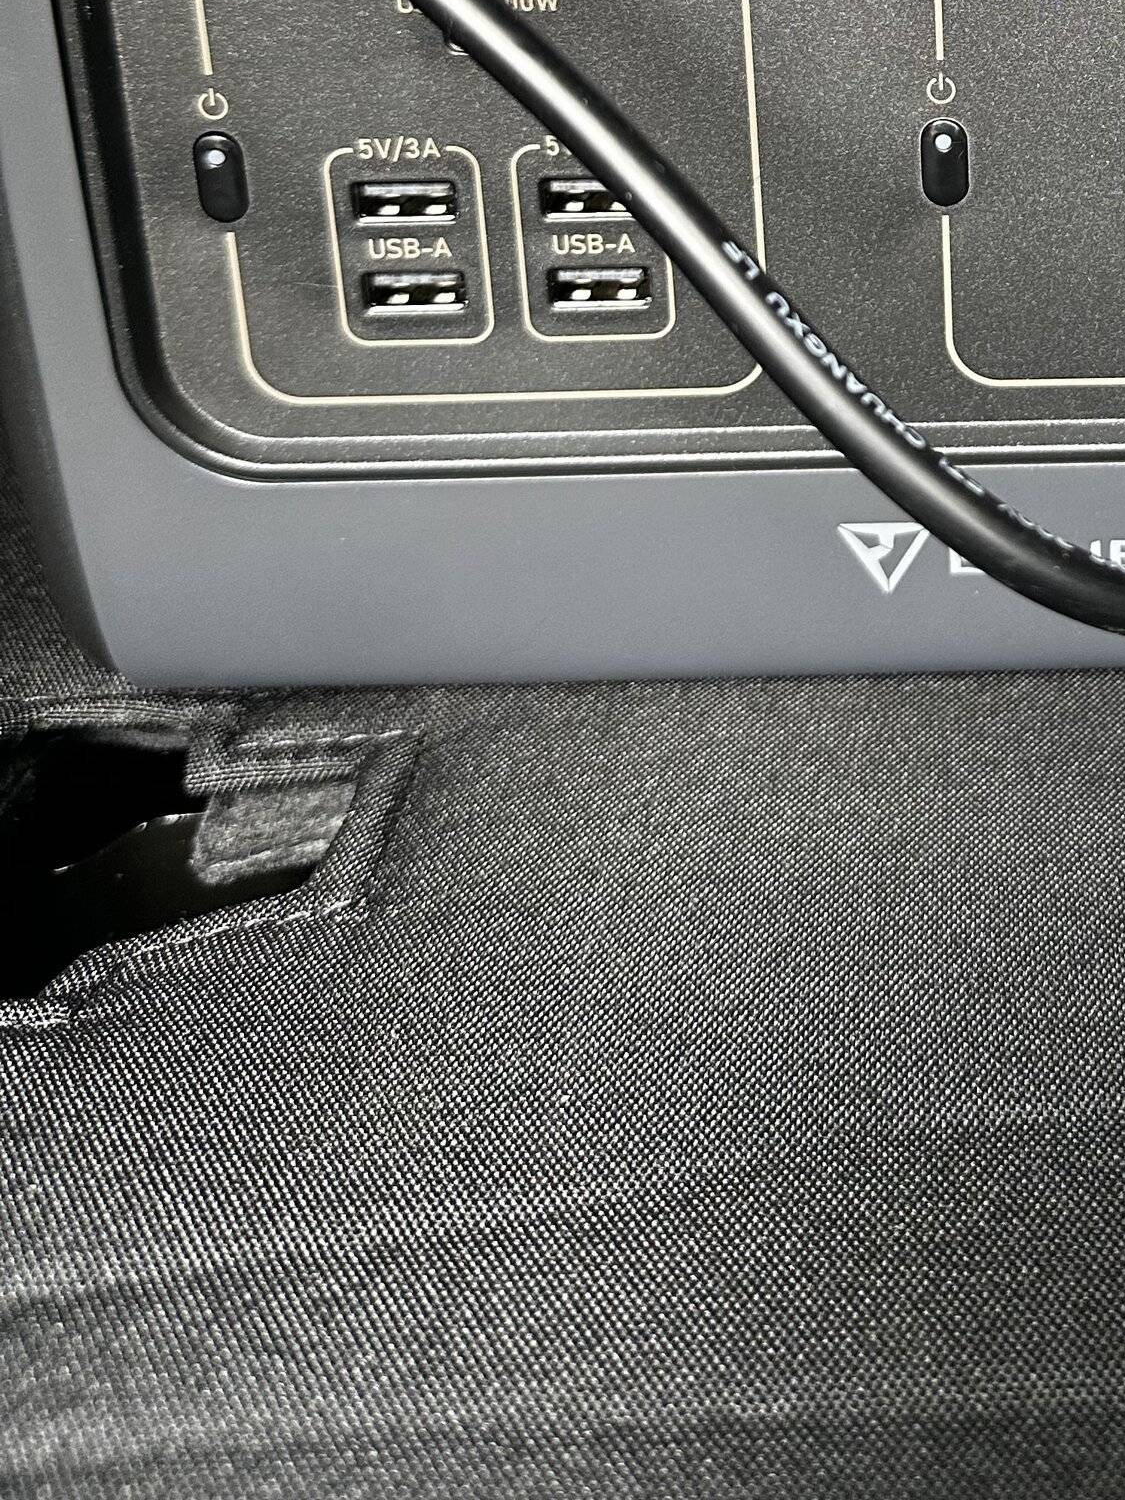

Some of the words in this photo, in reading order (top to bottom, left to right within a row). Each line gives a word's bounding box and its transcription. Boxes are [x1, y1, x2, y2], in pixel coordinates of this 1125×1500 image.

[358, 135, 442, 163] 5V/3A
[367, 236, 453, 260] USB-A
[551, 232, 636, 255] USB-A
